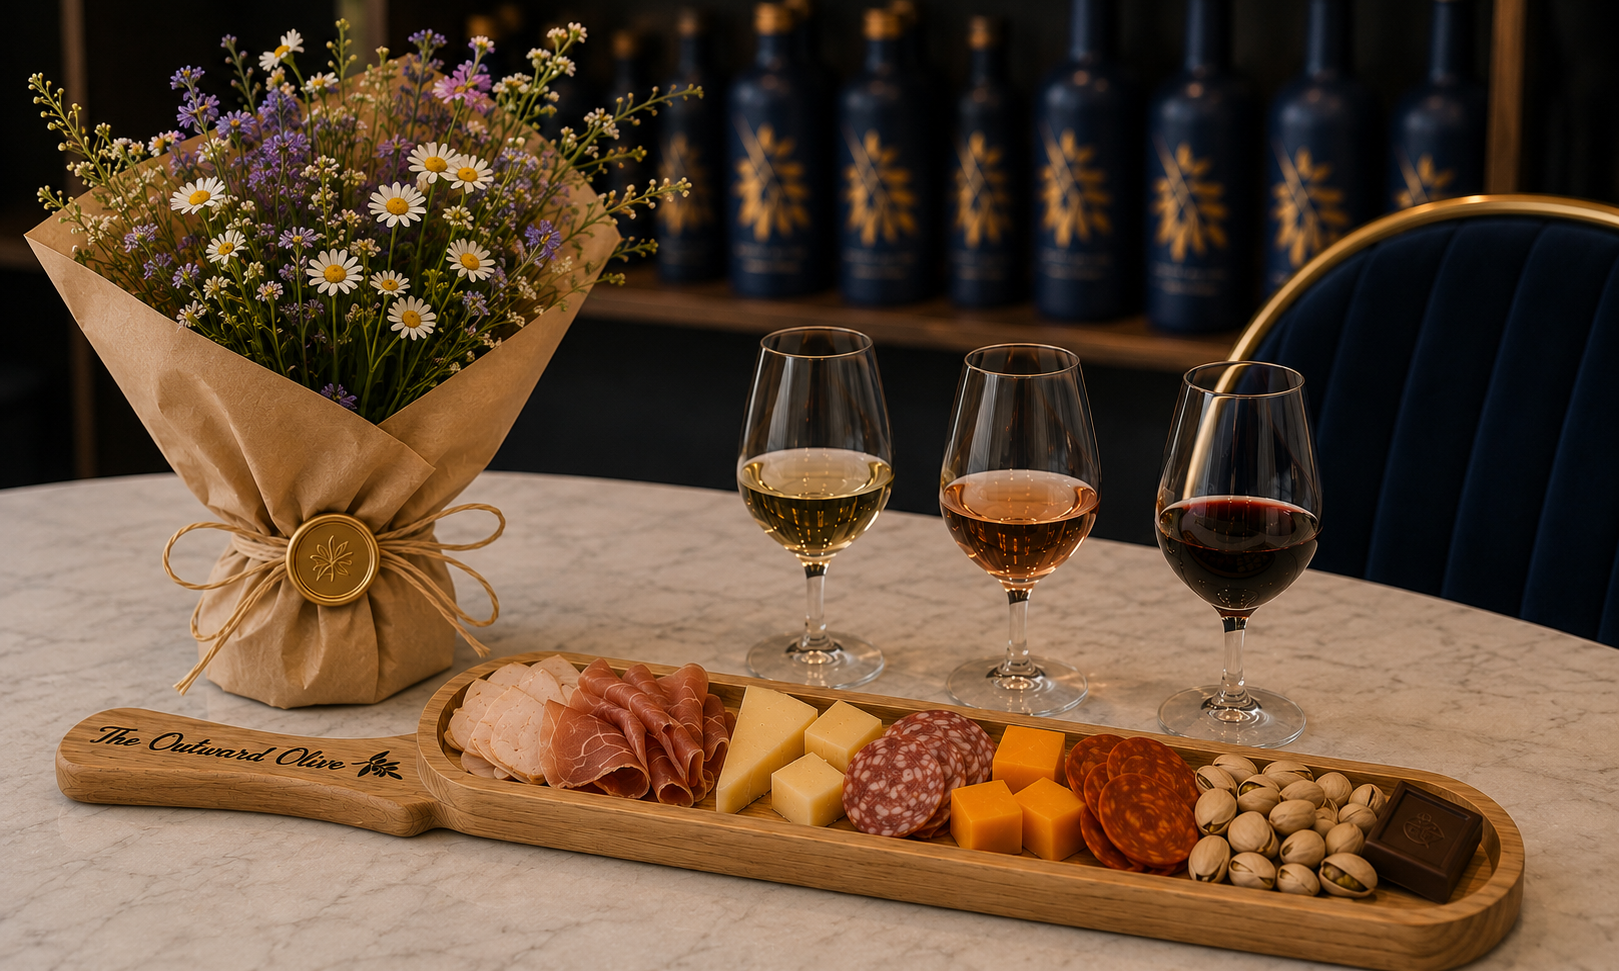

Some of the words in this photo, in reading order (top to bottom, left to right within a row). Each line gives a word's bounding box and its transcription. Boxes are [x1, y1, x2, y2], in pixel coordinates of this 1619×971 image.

[89, 726, 141, 747] The
[148, 731, 277, 763] Outward
[275, 747, 346, 771] Olive
